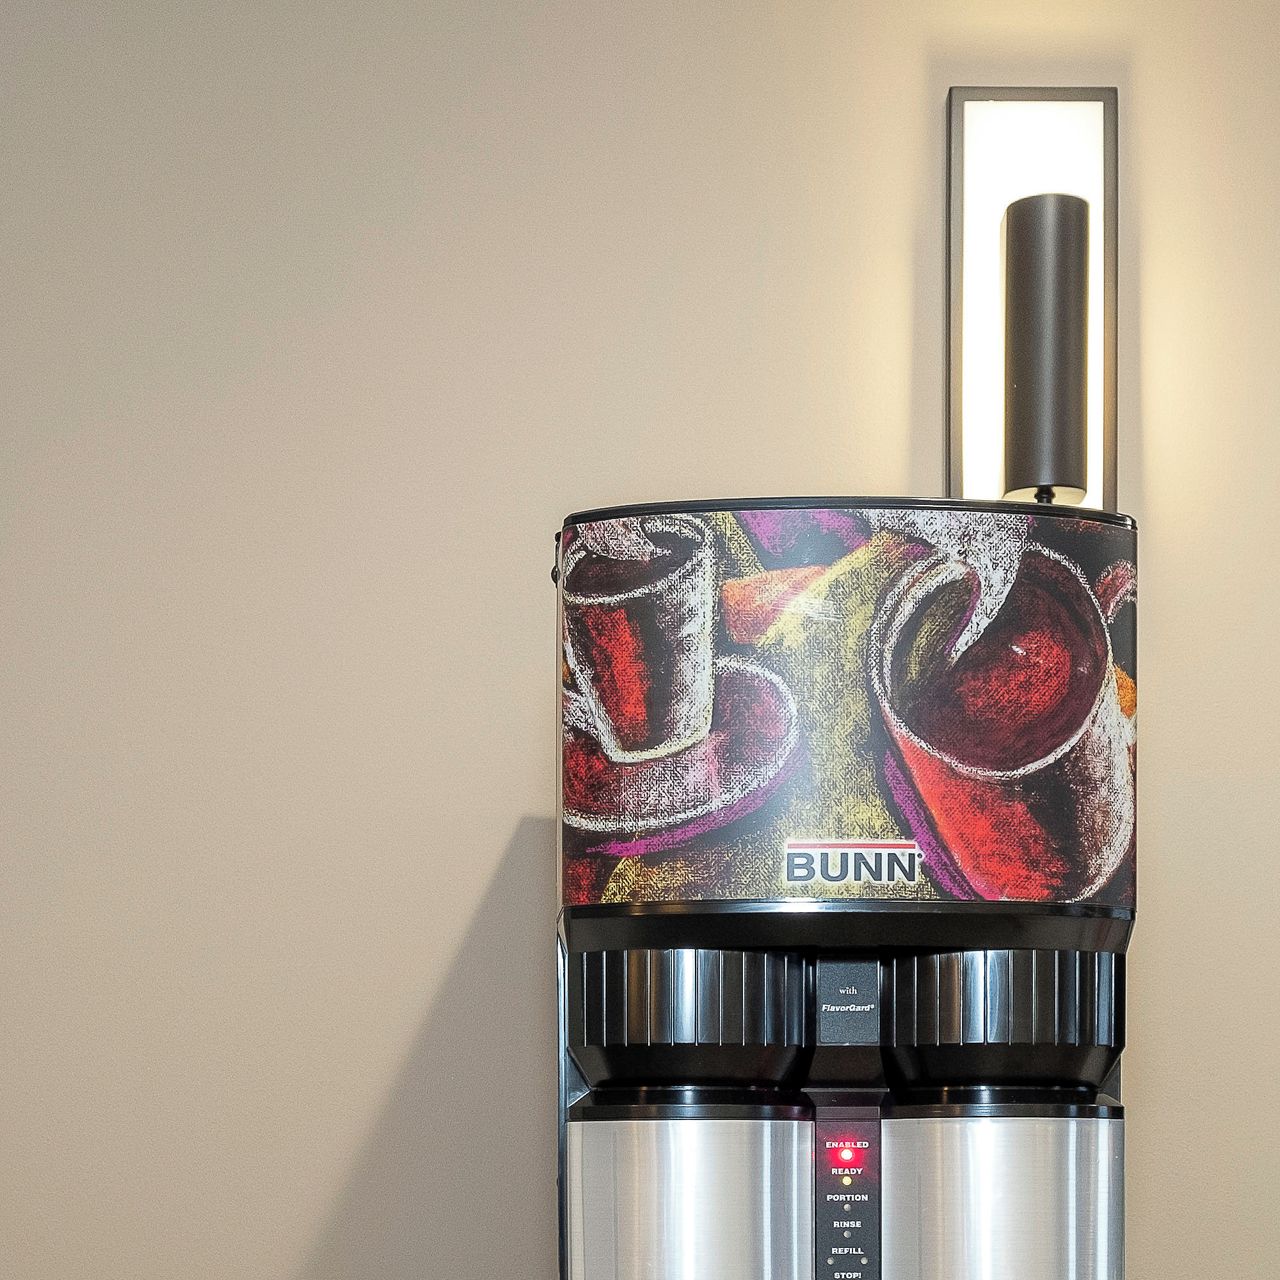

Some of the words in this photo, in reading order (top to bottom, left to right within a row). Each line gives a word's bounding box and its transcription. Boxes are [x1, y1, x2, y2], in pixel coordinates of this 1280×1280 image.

[786, 852, 916, 882] BUNN
[839, 986, 858, 995] with
[825, 1141, 870, 1149] ENABLED
[831, 1167, 864, 1175] READY
[826, 1194, 869, 1202] PORTION
[833, 1220, 862, 1228] RINSE
[831, 1247, 865, 1255] REFILL
